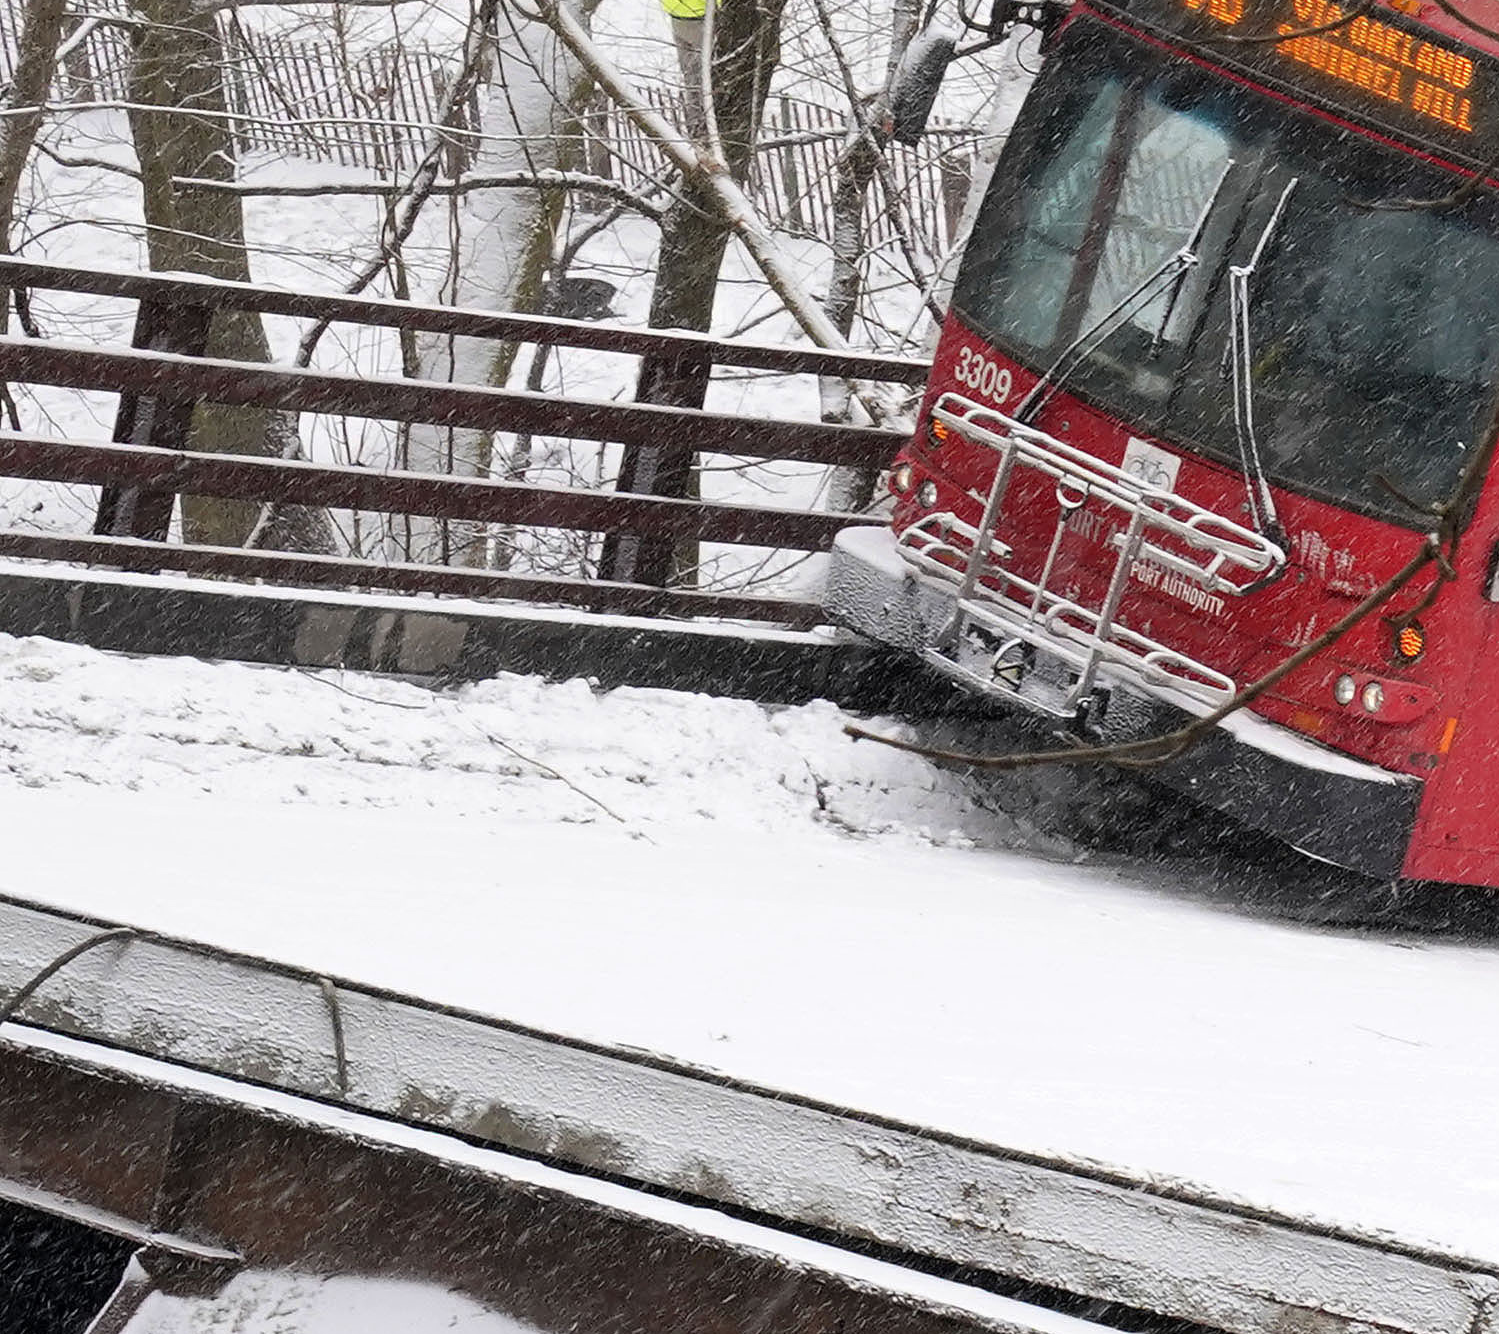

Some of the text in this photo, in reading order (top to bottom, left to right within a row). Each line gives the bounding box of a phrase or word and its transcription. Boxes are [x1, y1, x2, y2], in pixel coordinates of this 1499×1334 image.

[1349, 15, 1474, 91] OAKLAND
[1411, 79, 1473, 133] HILL
[954, 346, 1012, 404] 3309
[1130, 560, 1225, 616] PORT AUTHORITY
